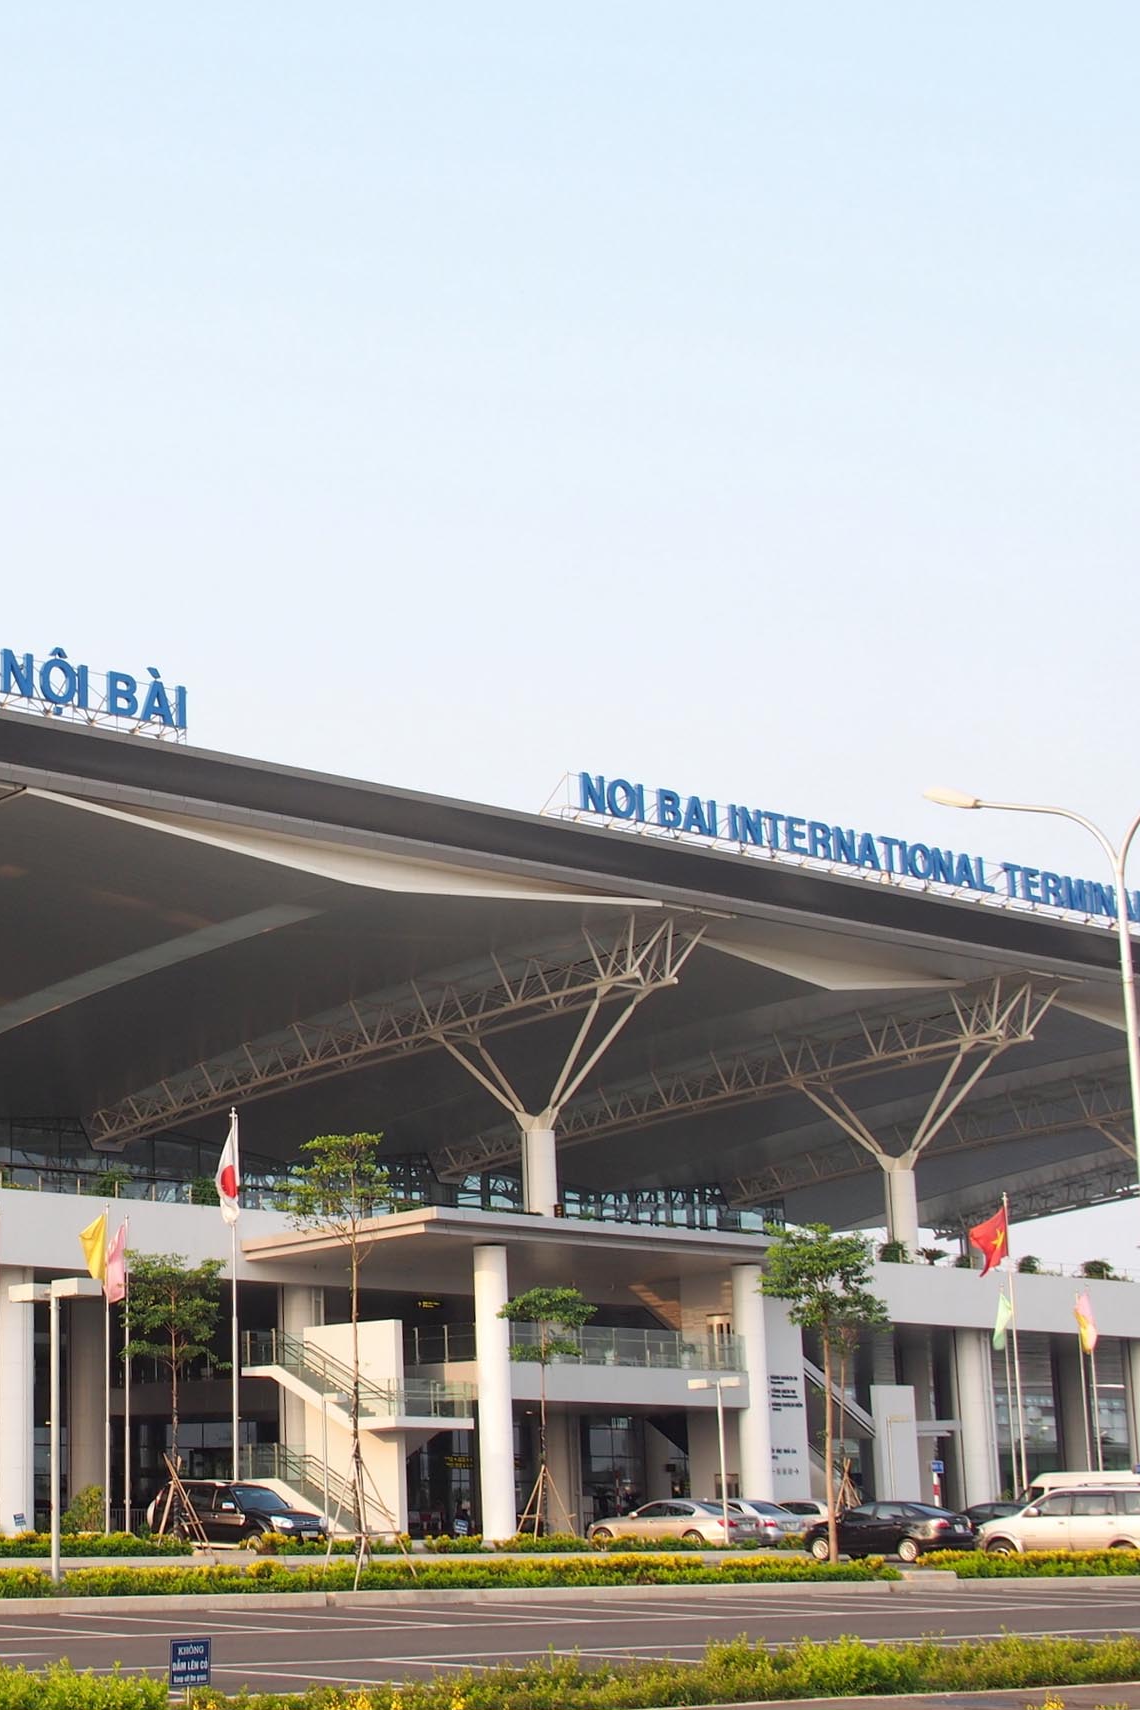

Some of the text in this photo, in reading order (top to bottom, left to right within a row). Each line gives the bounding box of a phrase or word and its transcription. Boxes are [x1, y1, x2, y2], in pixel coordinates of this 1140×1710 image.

[0, 646, 89, 715] NỘI
[106, 666, 188, 730] BÀI
[579, 771, 645, 823] NOI
[656, 787, 717, 836] BAI
[727, 802, 996, 894] INTERNATIONAL
[177, 1643, 205, 1656] KHÔNG
